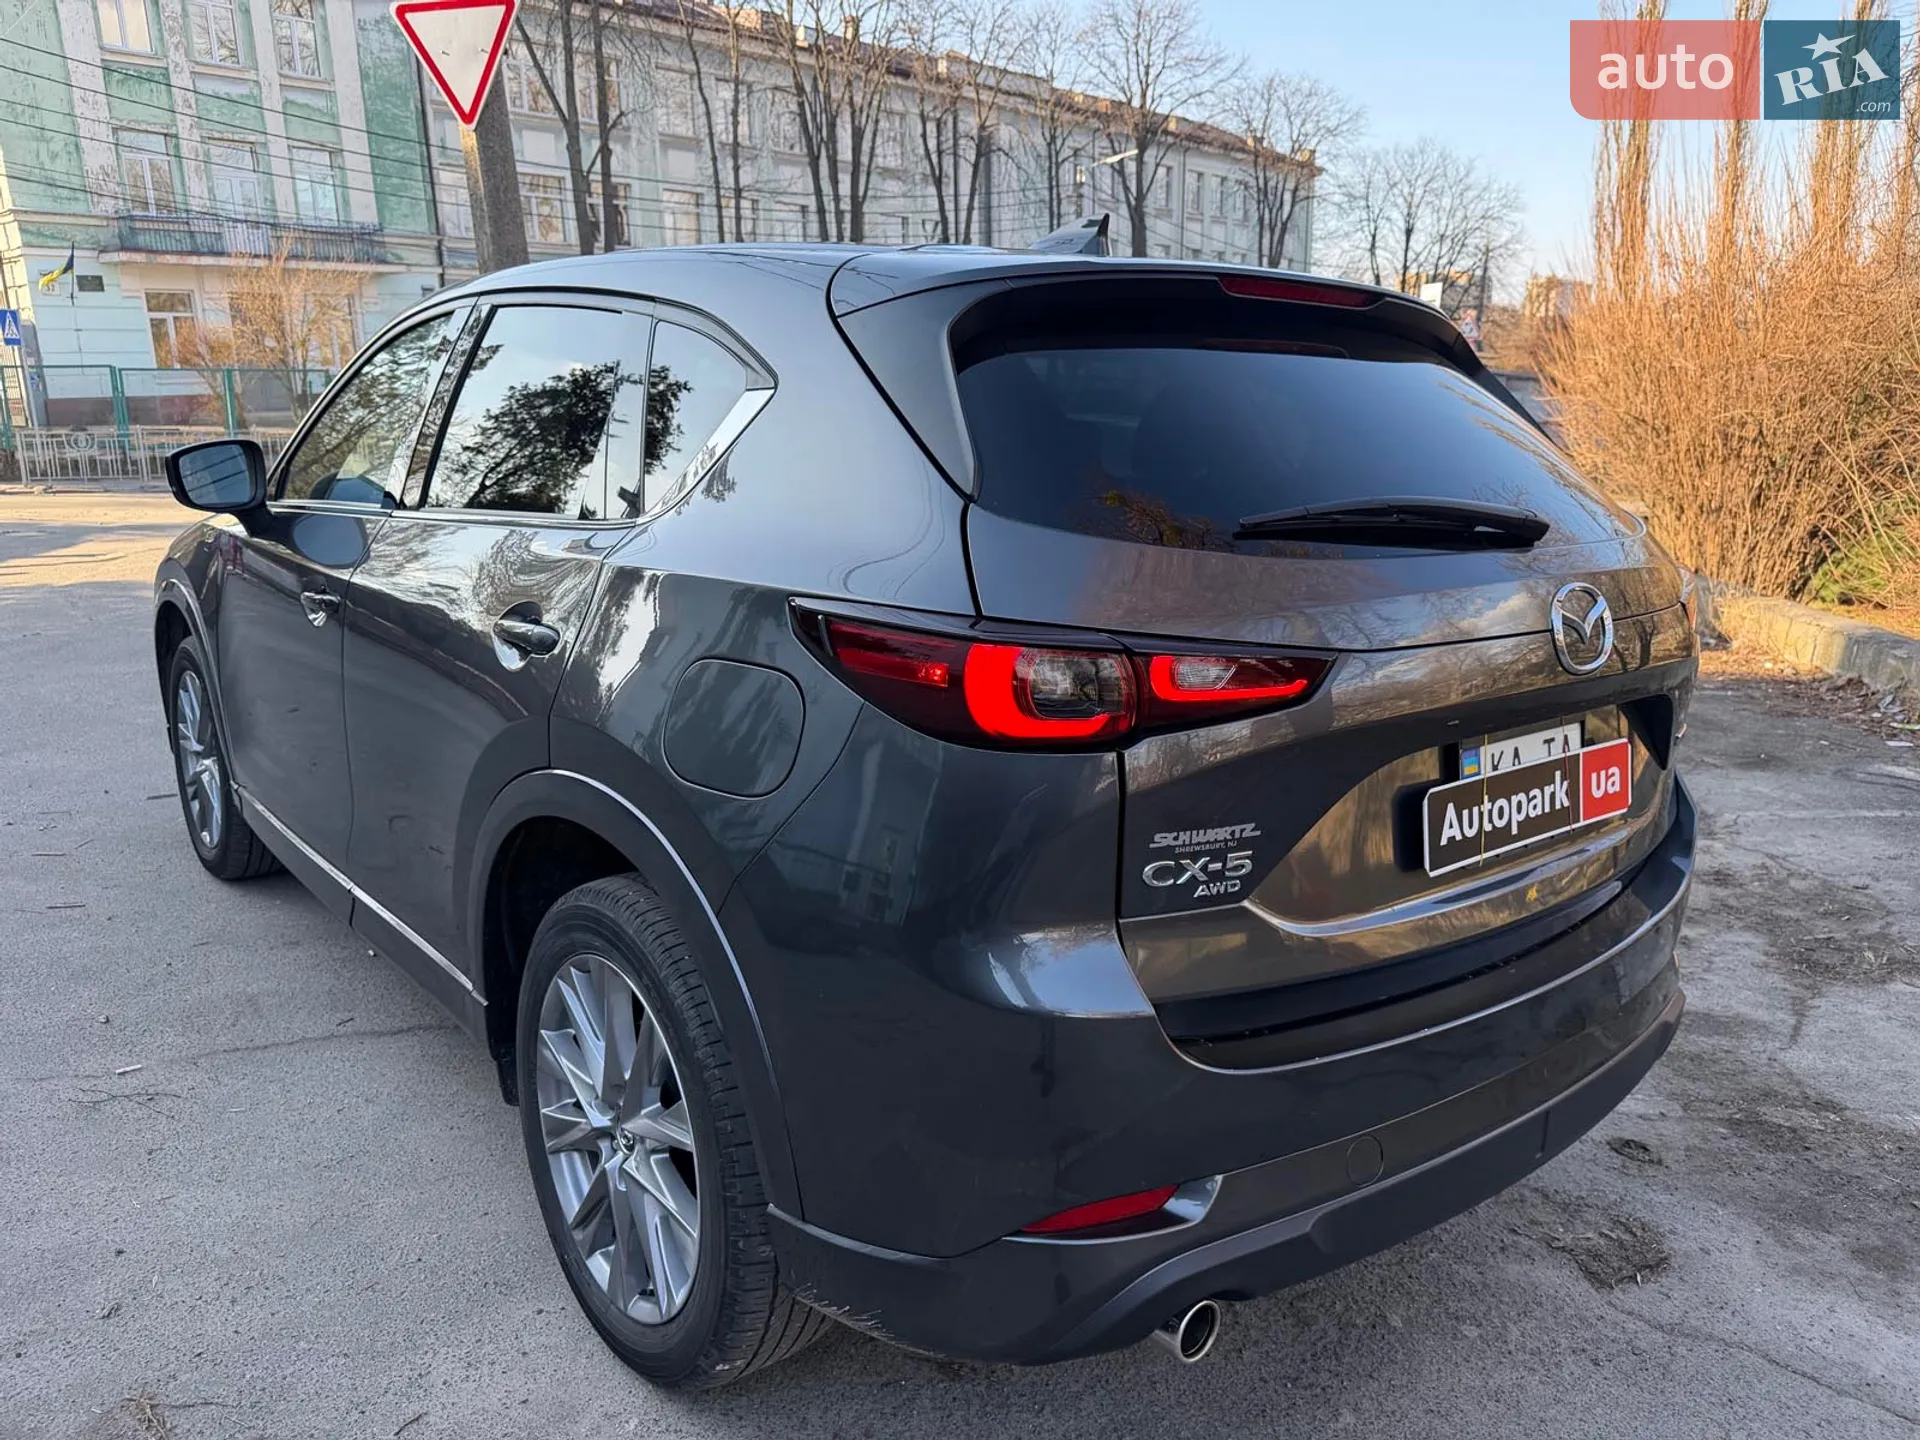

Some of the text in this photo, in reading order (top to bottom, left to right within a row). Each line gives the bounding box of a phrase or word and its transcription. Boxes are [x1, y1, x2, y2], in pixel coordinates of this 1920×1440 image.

[1440, 766, 1621, 846] Autopark ua
[1149, 822, 1261, 848] SCHWARTZ
[1142, 850, 1253, 887] CX-5
[1193, 880, 1241, 898] AWD
